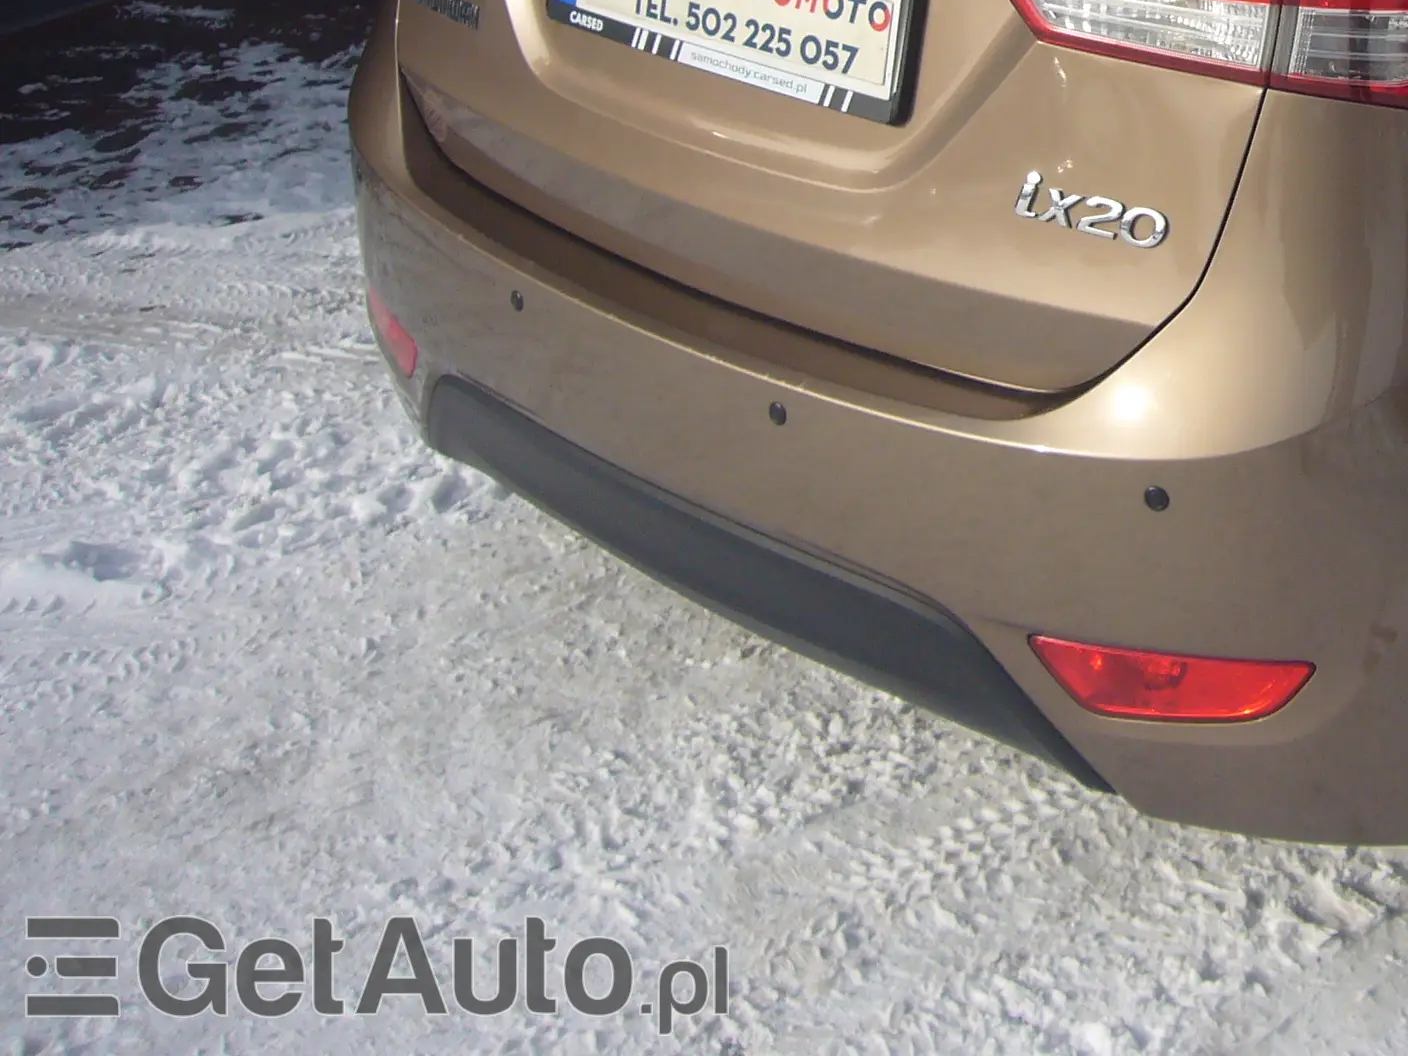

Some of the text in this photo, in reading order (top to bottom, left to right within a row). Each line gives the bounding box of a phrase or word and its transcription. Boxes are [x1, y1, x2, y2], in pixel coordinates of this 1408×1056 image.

[569, 10, 604, 32] CARSED
[685, 1, 737, 43] 502
[743, 18, 793, 58] 225
[799, 34, 860, 75] 057
[690, 50, 808, 94] samochody.carsed.pl
[1014, 170, 1170, 249] ix20
